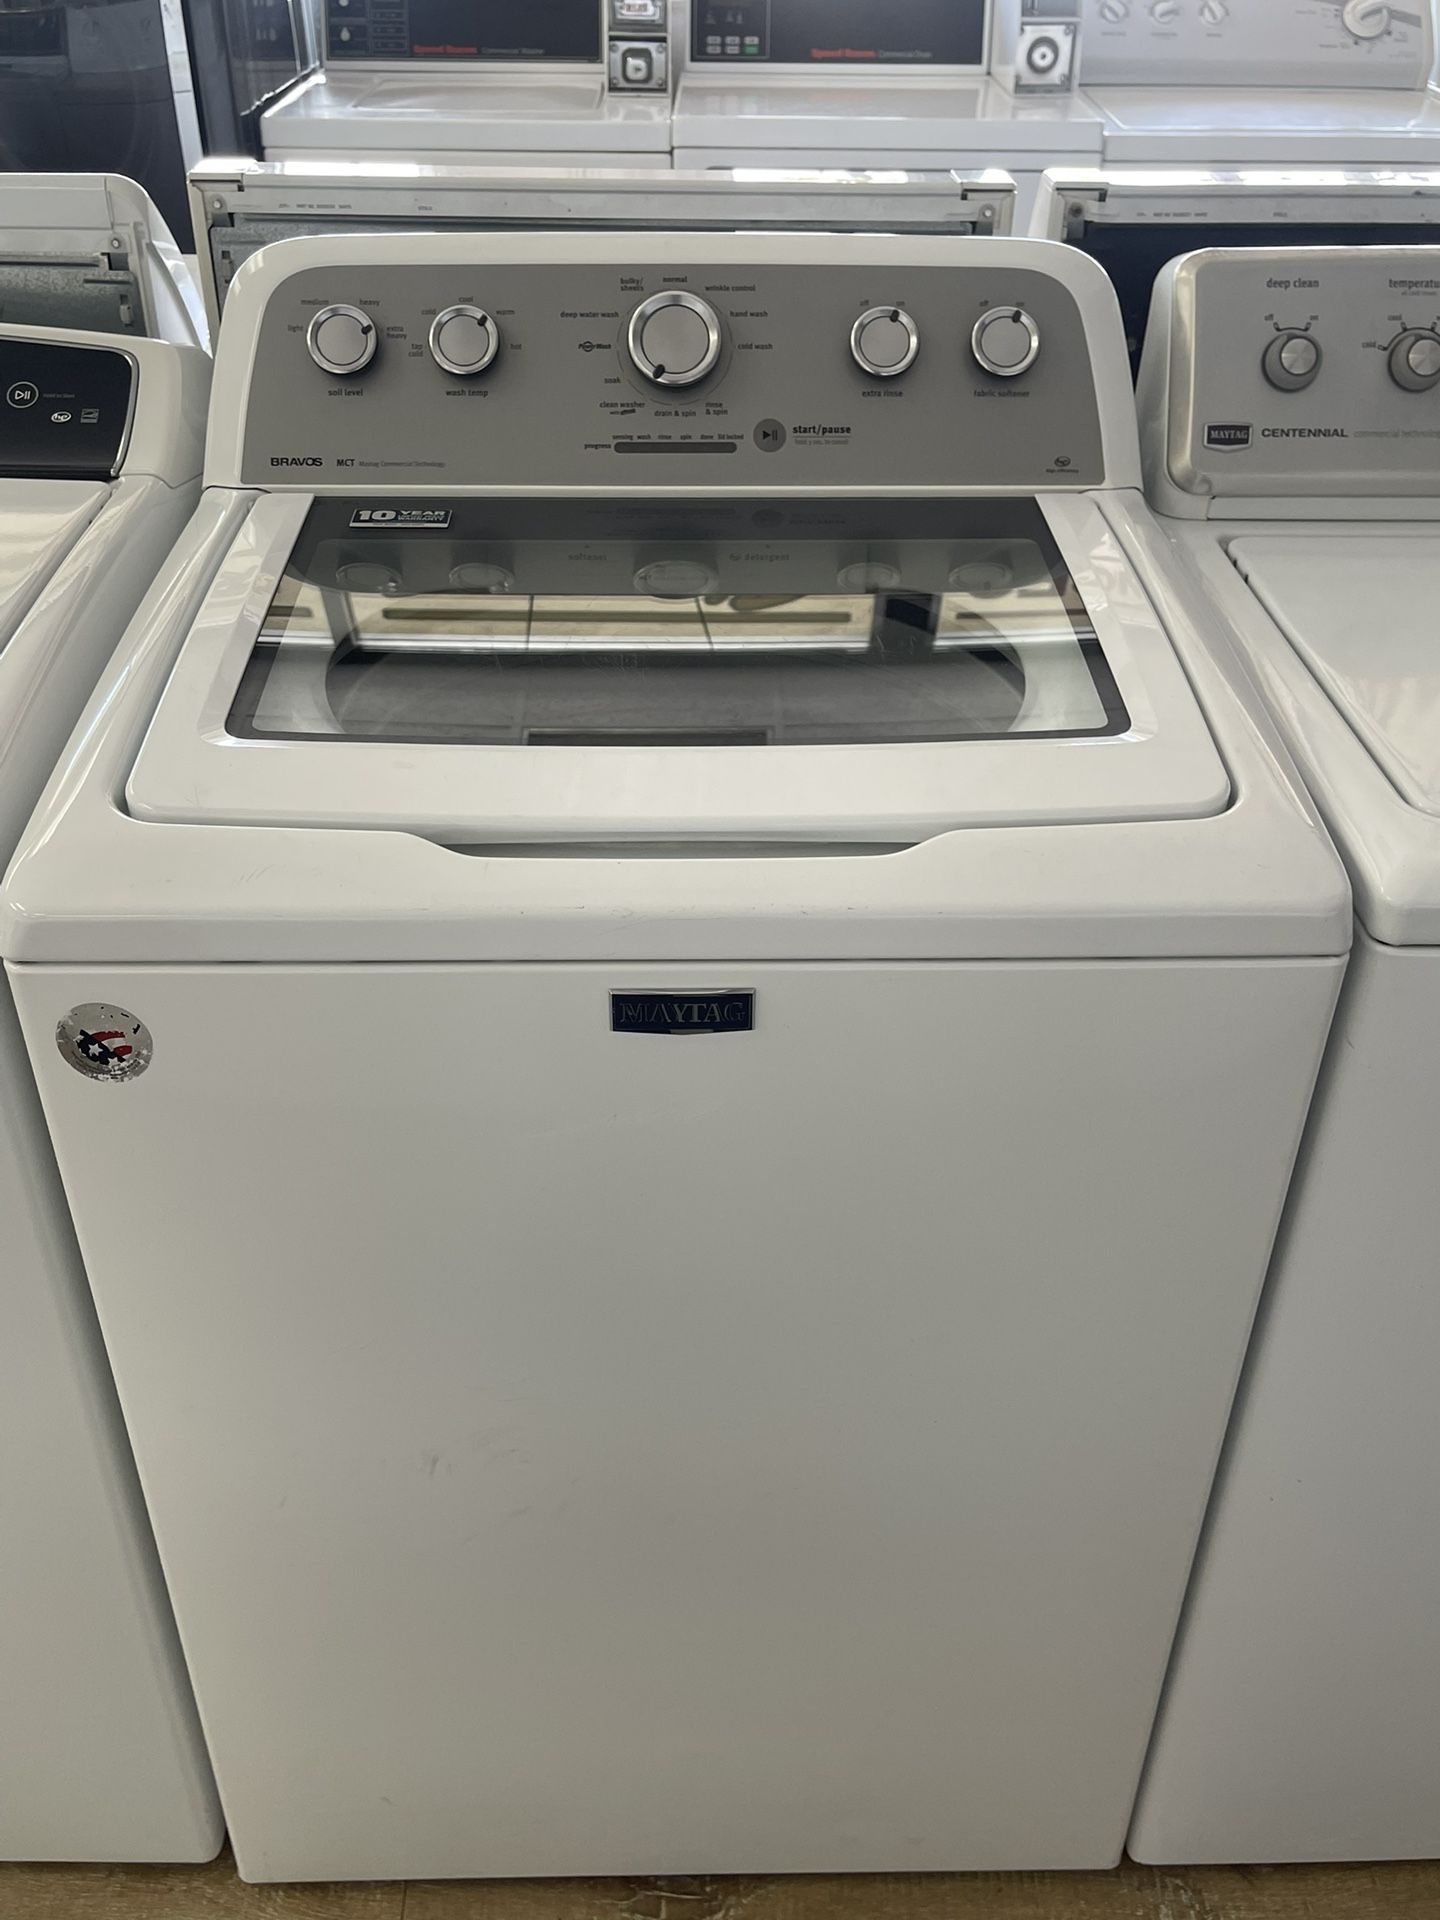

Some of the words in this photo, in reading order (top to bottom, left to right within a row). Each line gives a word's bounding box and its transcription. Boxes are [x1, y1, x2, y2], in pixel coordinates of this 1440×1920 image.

[662, 275, 688, 284] normal
[1266, 276, 1291, 291] deep
[1293, 276, 1319, 289] clean
[705, 283, 730, 292] wrinkle
[731, 283, 756, 292] control
[358, 298, 381, 307] heavy
[560, 310, 578, 320] deep
[579, 310, 600, 319] water
[601, 310, 620, 319] wash
[729, 309, 748, 318] hand
[749, 309, 769, 318] wash
[386, 332, 408, 341] heavy
[737, 341, 753, 350] cold
[754, 341, 774, 350] wash
[604, 376, 621, 384] soak
[327, 388, 344, 397] soil
[345, 388, 364, 397] level
[445, 388, 467, 397] wash
[468, 388, 490, 399] temp
[862, 389, 882, 398] extra
[883, 389, 904, 398] rinse
[973, 389, 996, 398] fabric
[998, 389, 1031, 398] softener
[599, 400, 619, 408] clean
[620, 400, 646, 408] washer
[705, 401, 723, 409] rinse
[654, 408, 673, 417] drain
[674, 409, 681, 417] &
[682, 408, 697, 418] spin
[705, 408, 713, 416] &
[714, 407, 729, 417] spin
[792, 423, 852, 436] start/pause
[1210, 430, 1248, 439] MAYTAG
[1261, 427, 1349, 438] CENTENNIAL
[584, 442, 612, 451] progress
[270, 457, 324, 467] BRAVOS
[336, 458, 356, 467] MCT
[359, 510, 397, 520] 10
[744, 552, 791, 563] detergent
[618, 1001, 746, 1023] MAYTAG
